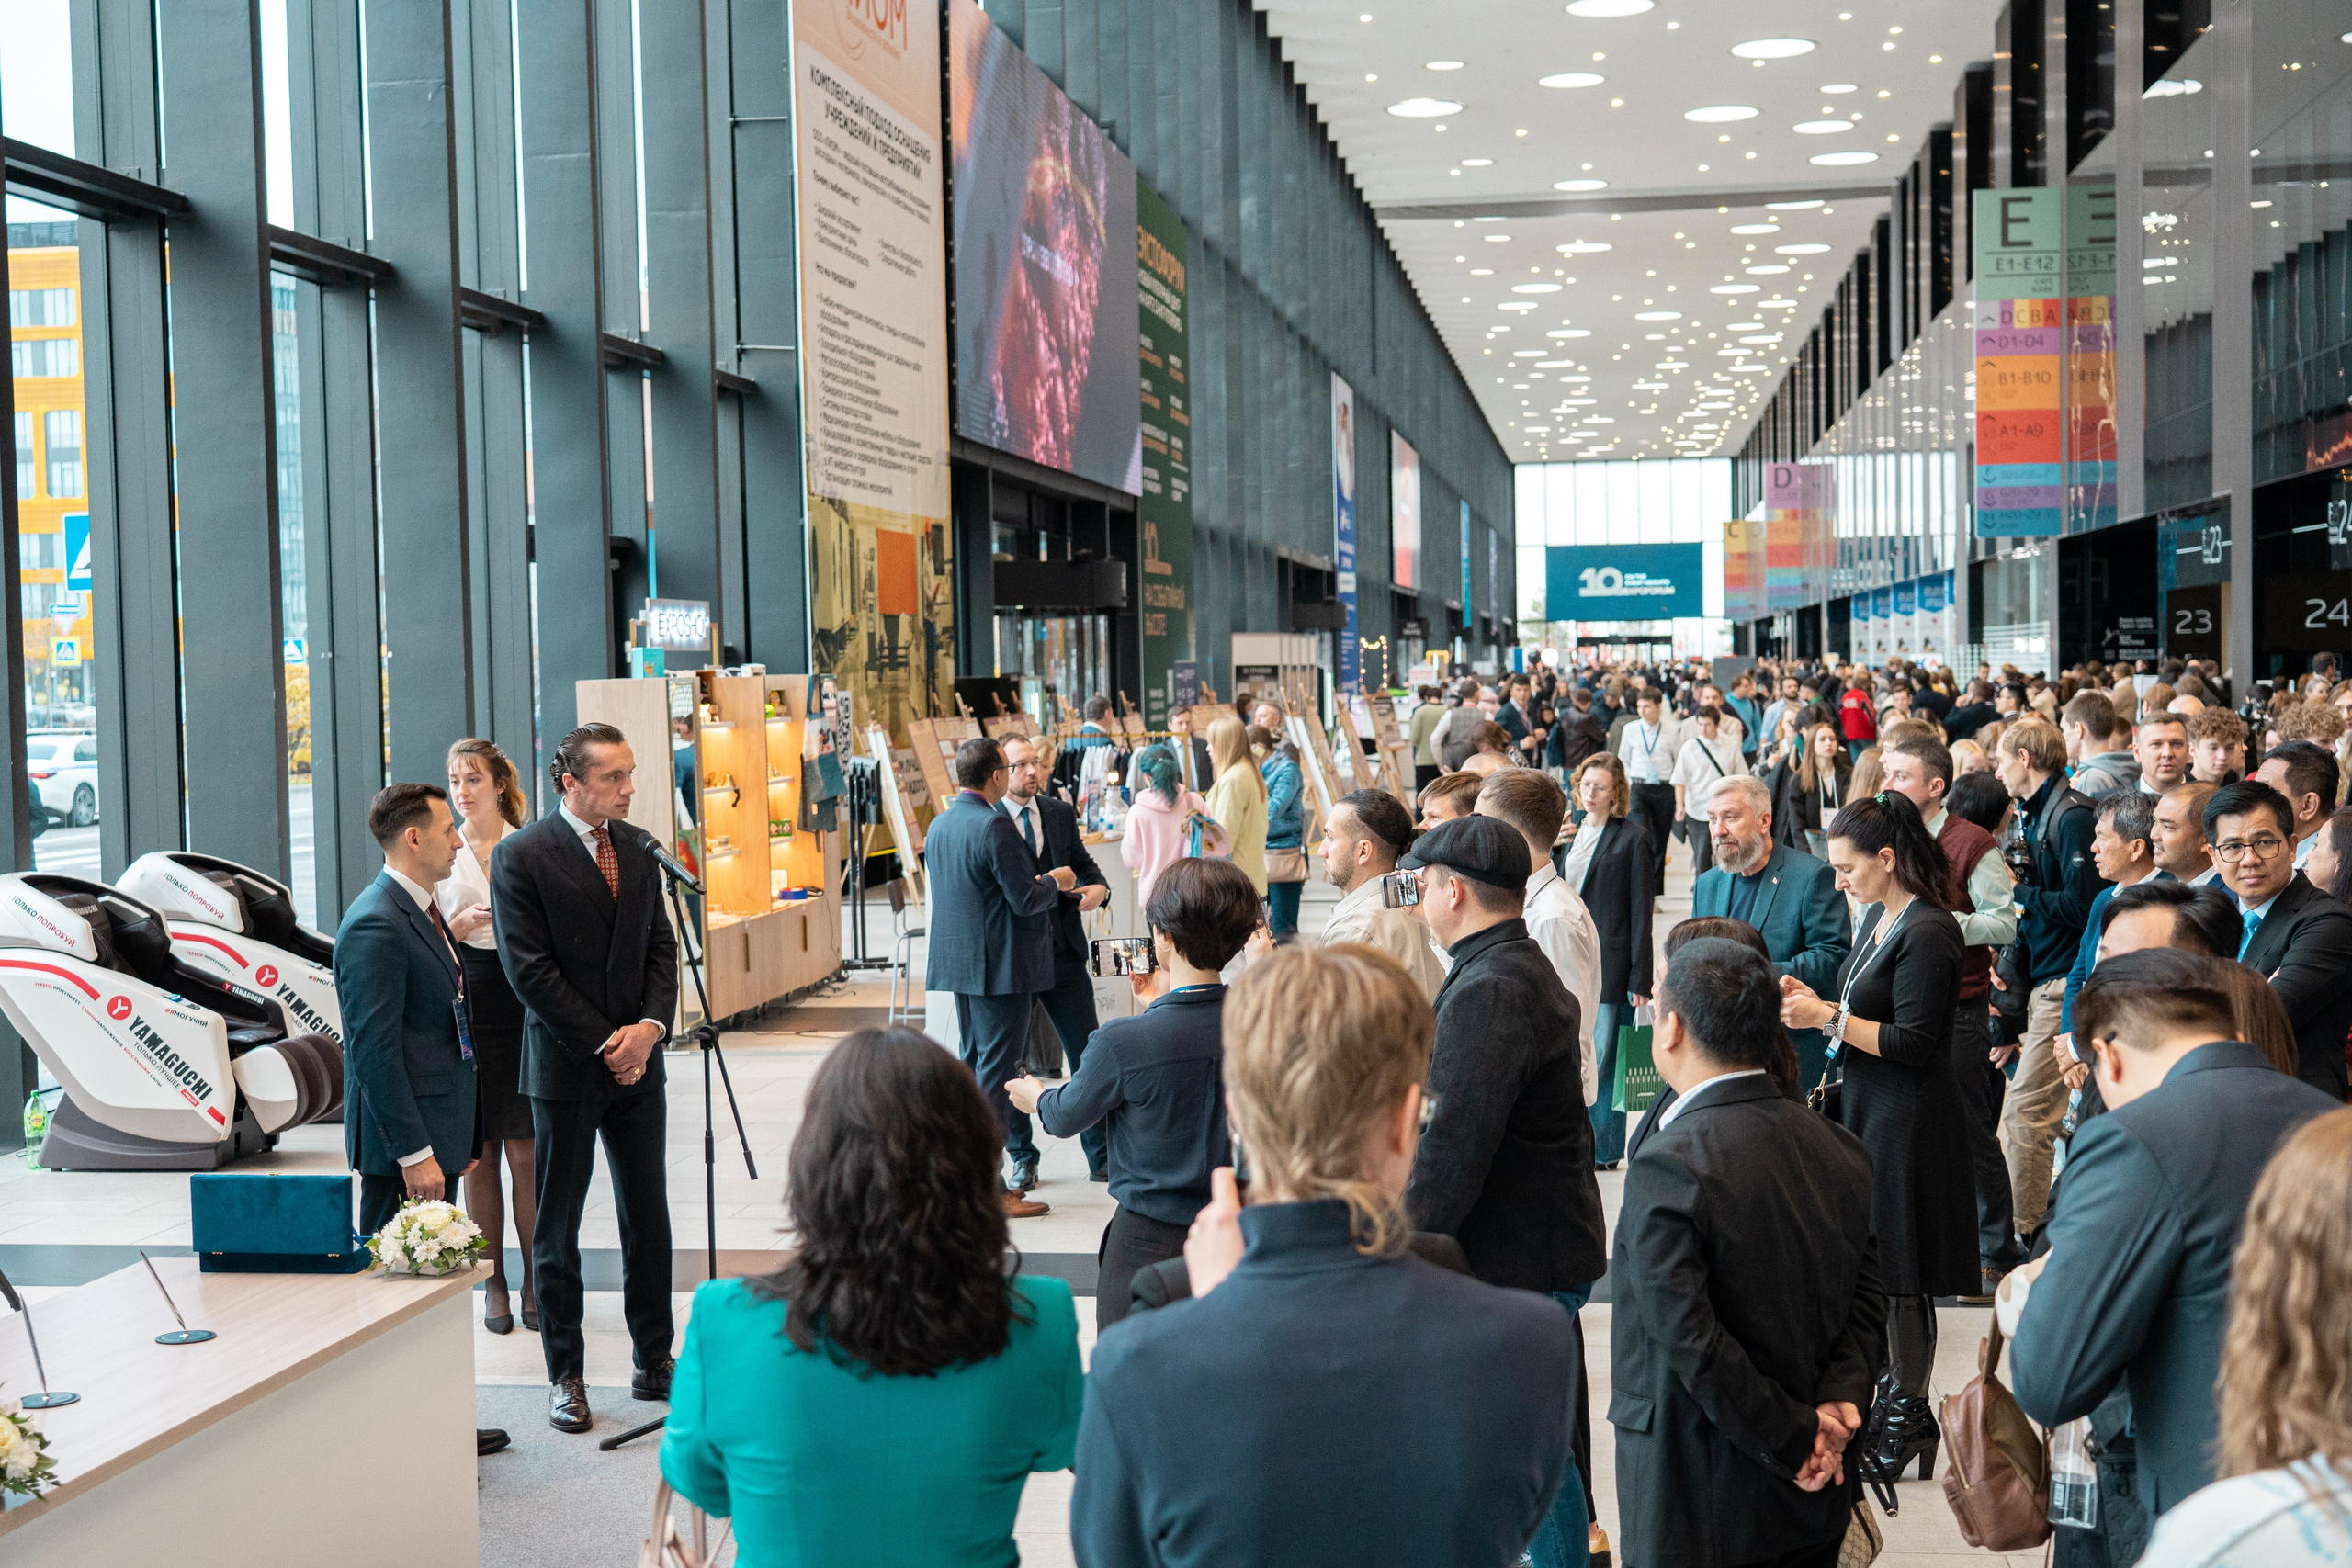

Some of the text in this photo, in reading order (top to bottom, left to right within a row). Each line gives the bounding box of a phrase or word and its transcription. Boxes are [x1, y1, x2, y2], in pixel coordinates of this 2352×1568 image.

[810, 64, 931, 164] КОМПЛЕКСНЫЙ ПОДХОД ОСНАЩЕНИЯ
[824, 100, 871, 146] УЧРЕЖДЕНИЙ
[879, 139, 922, 180] ПРЕДПРИЯТИЙ
[2000, 196, 2033, 248] E
[1773, 467, 1792, 489] D
[1727, 523, 1739, 539] C
[1578, 566, 1623, 597] 10
[658, 612, 710, 639] EXPOSHOP
[2175, 609, 2212, 634] 23
[2305, 598, 2351, 629] 24
[164, 873, 225, 920] ТОЛЬКО ПОПРОБУЙ
[11, 896, 76, 947] ТОЛЬКО ПОПРОБУЙ
[232, 985, 265, 1006] YAMAGUCHI
[308, 975, 334, 987] #ЯМОГУ
[164, 1007, 209, 1028] #ЯМОГУЧИЙ
[276, 983, 344, 1045] YAMAGUC
[52, 986, 81, 1006] ИММУНИТЕТ
[81, 1005, 97, 1021] СНИМИ
[96, 1020, 124, 1048] НАПРЯЖЕНИЕ
[123, 1046, 151, 1075] ВОССТАНОВИ
[149, 1074, 163, 1088] СИЛЫ
[129, 1015, 214, 1101] YAMAGUCHI
[133, 1041, 182, 1089] ТОЛЬКО ЛУЧШЕЕ
